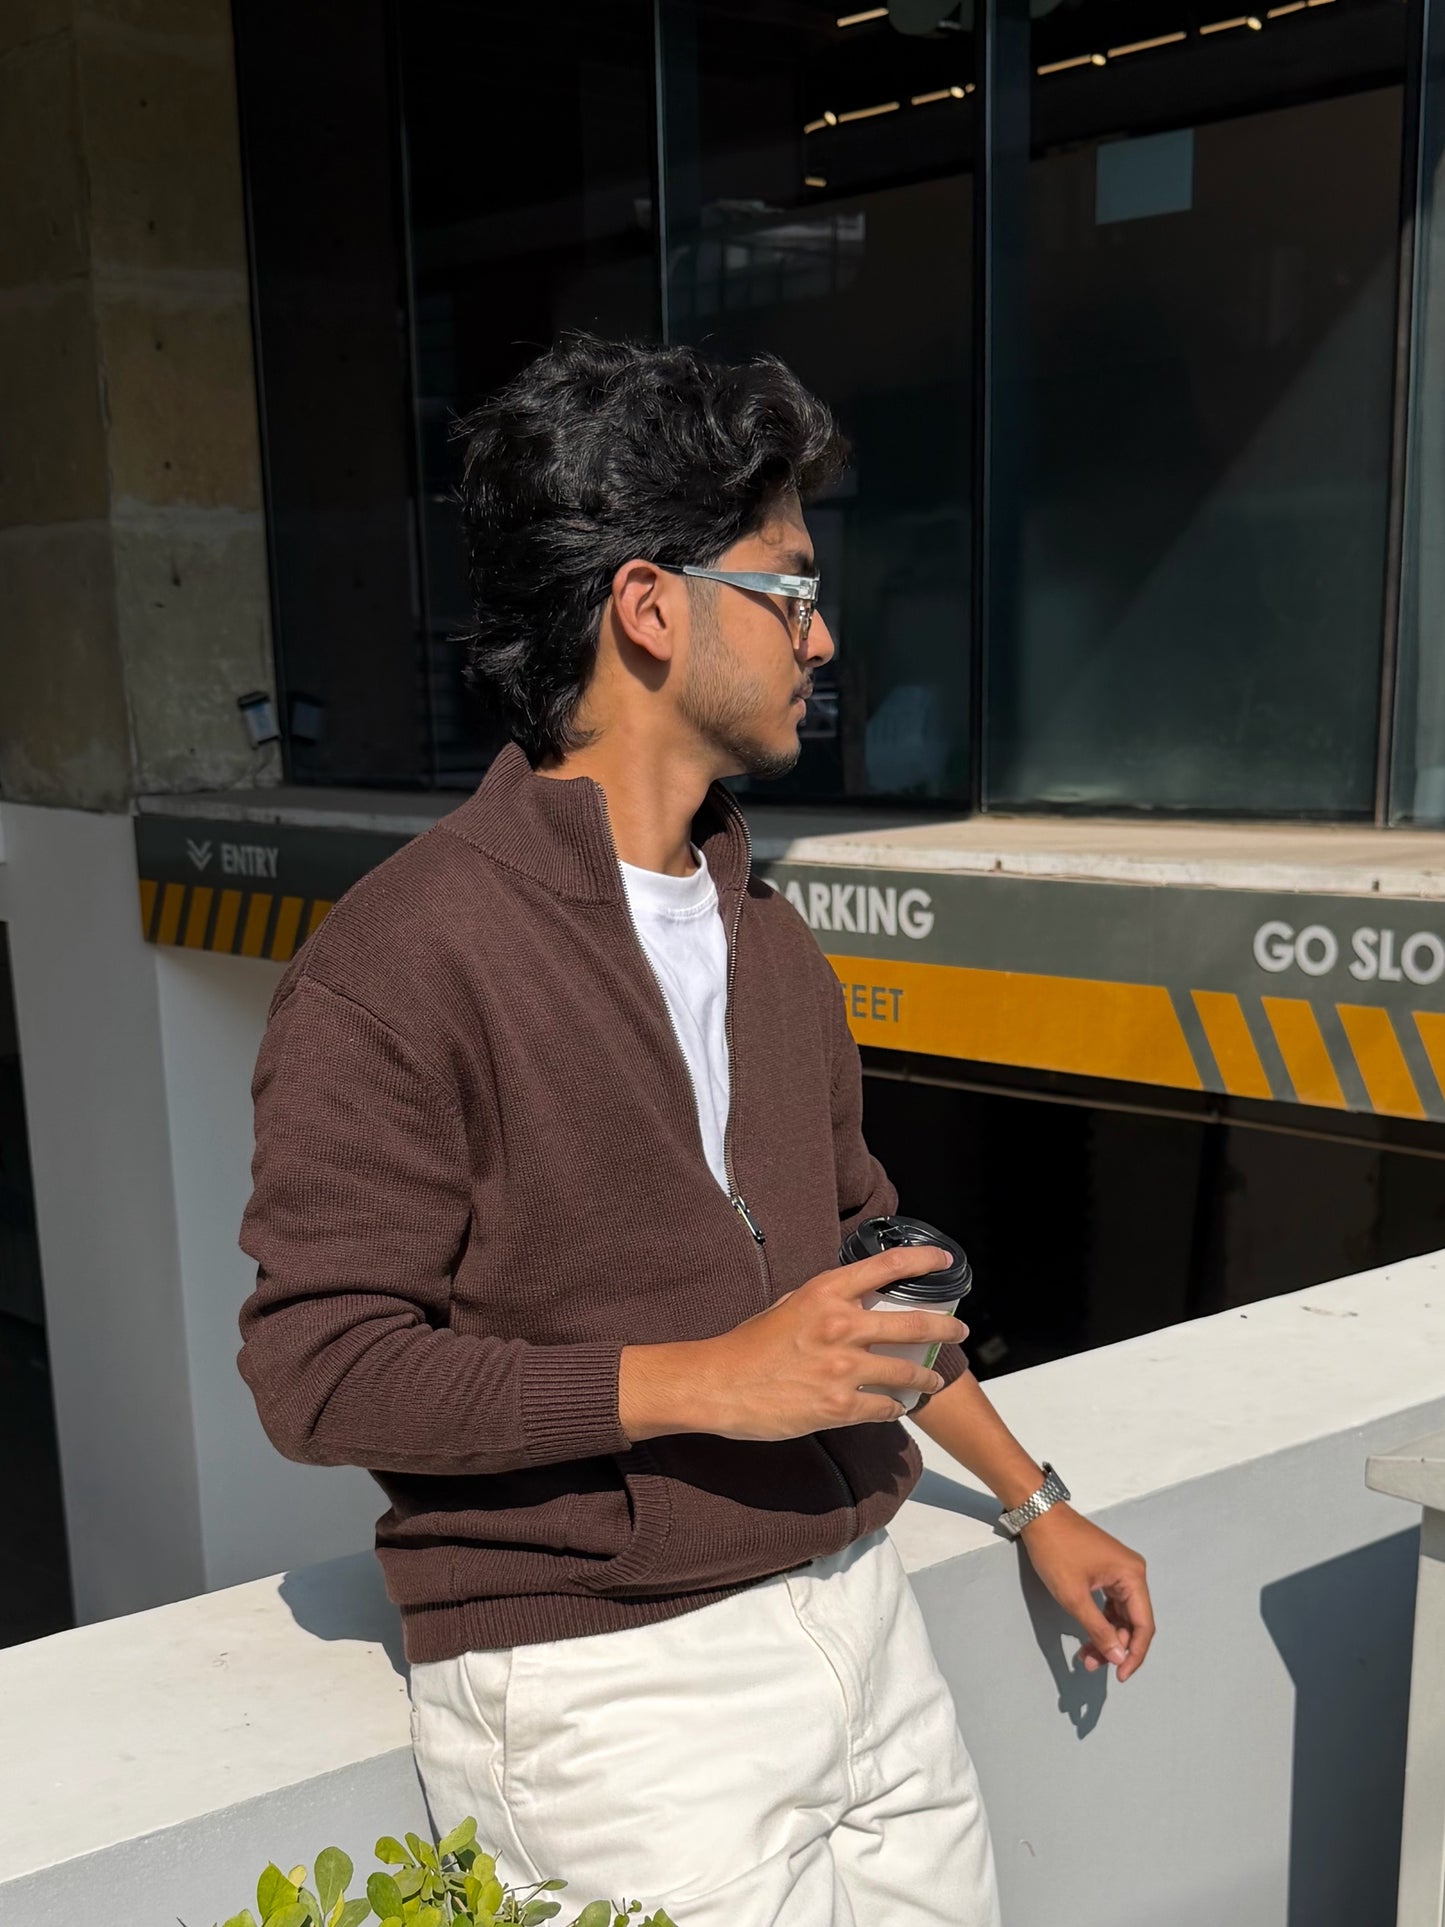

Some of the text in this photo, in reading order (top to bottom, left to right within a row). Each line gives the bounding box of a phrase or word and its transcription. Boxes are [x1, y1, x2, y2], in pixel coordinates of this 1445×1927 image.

[220, 842, 279, 878] ENTRY
[762, 878, 935, 940] ARKING
[1253, 920, 1445, 986] GO SLO
